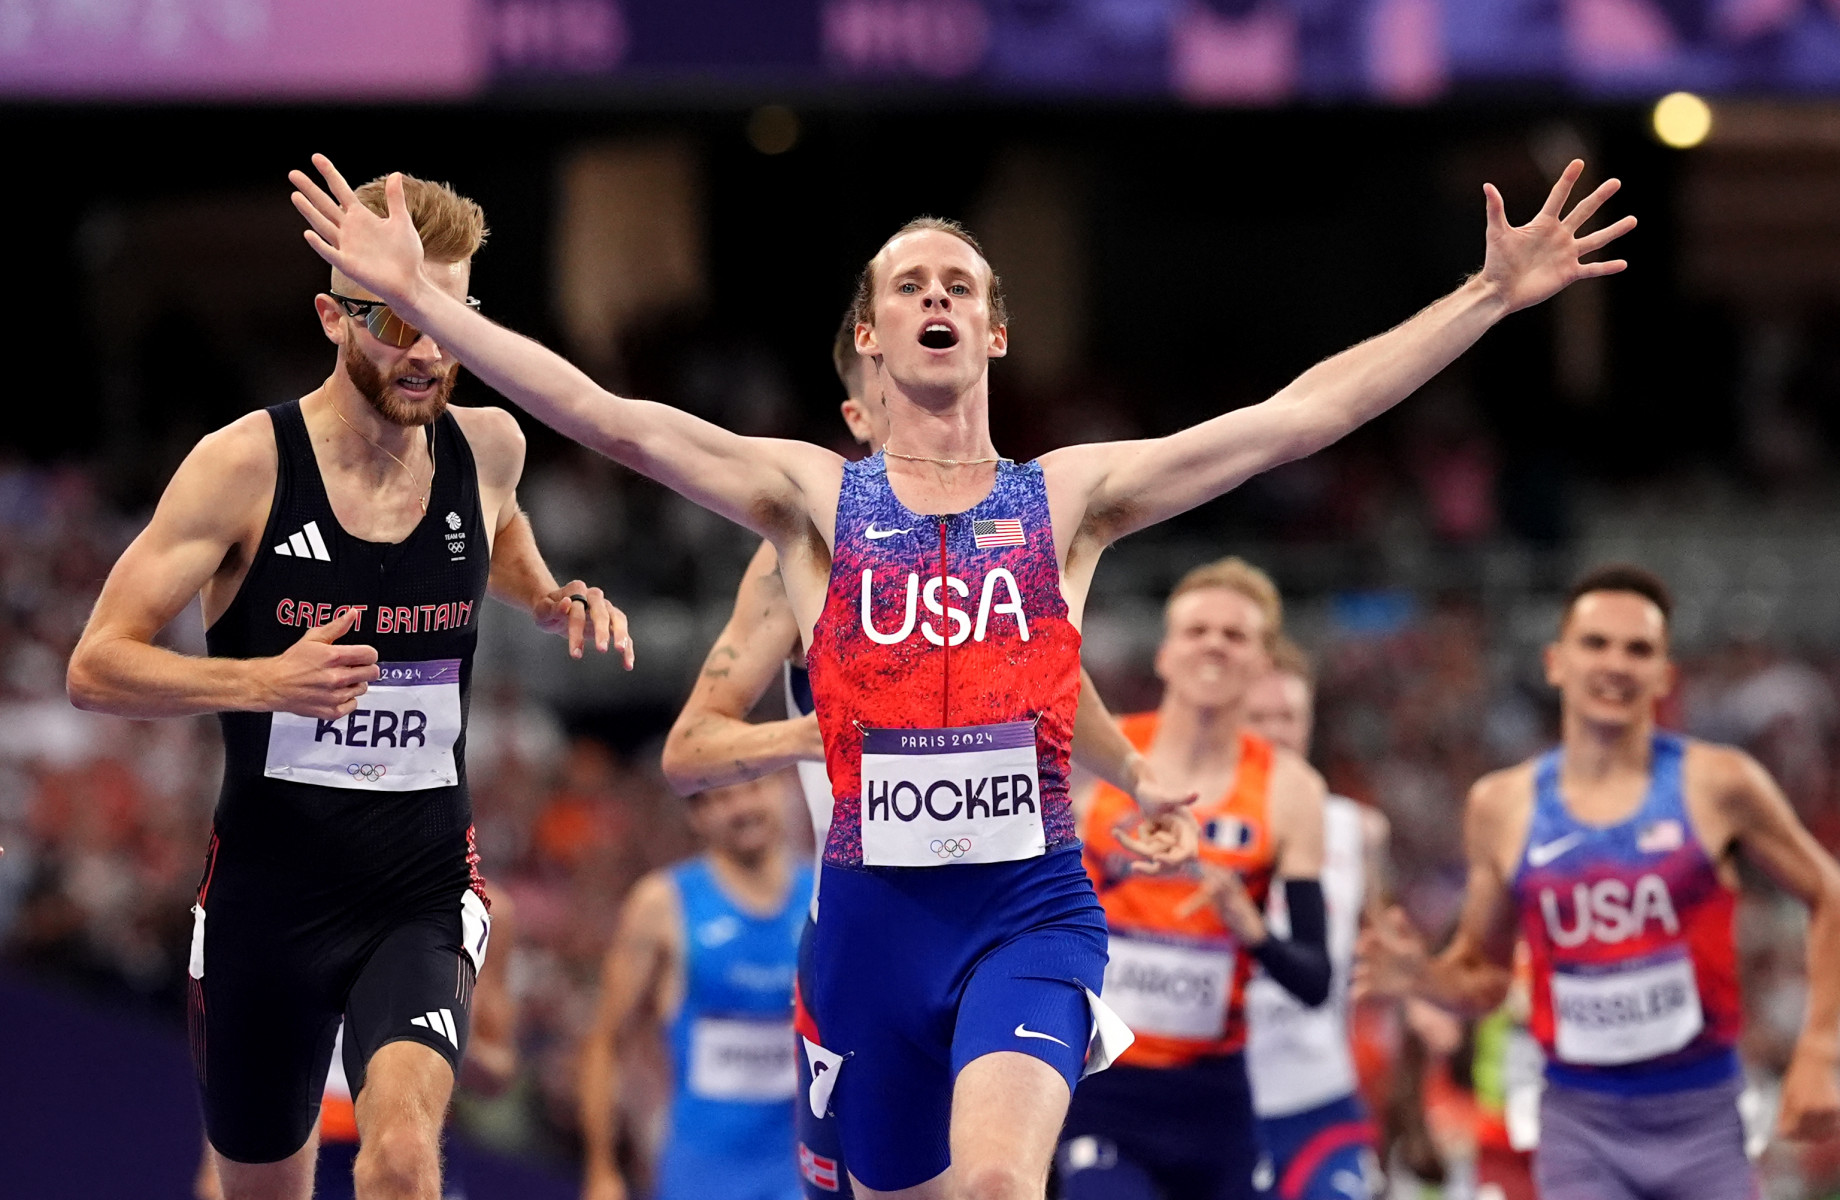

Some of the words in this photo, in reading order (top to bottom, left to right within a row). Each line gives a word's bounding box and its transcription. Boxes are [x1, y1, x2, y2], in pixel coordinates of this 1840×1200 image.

[277, 598, 368, 632] GREAT
[376, 600, 473, 634] BRITAIN
[861, 567, 1030, 647] USA
[381, 668, 422, 680] 2024
[314, 709, 428, 748] KERR
[901, 735, 945, 748] PARIS
[951, 732, 993, 746] 2024
[868, 773, 1036, 822] HOCKER
[1539, 874, 1680, 948] USA
